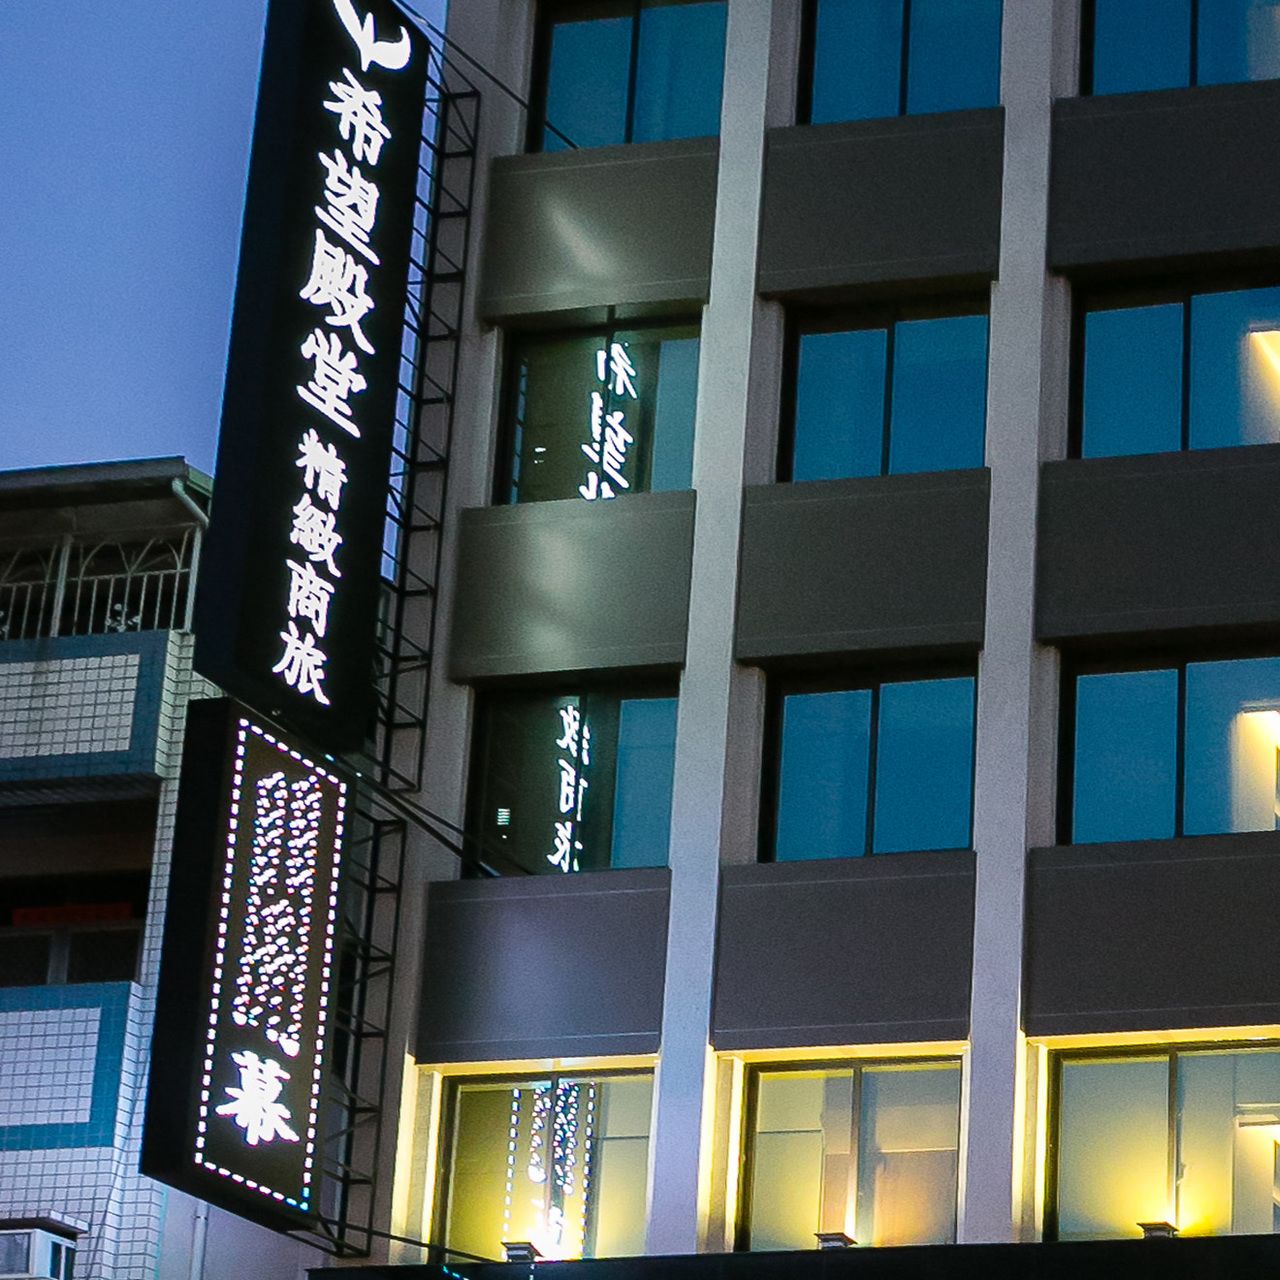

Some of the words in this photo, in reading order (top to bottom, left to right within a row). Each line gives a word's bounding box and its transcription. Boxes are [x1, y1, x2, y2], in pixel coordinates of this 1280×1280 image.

[271, 67, 391, 706] 希望殿堂精緻商旅
